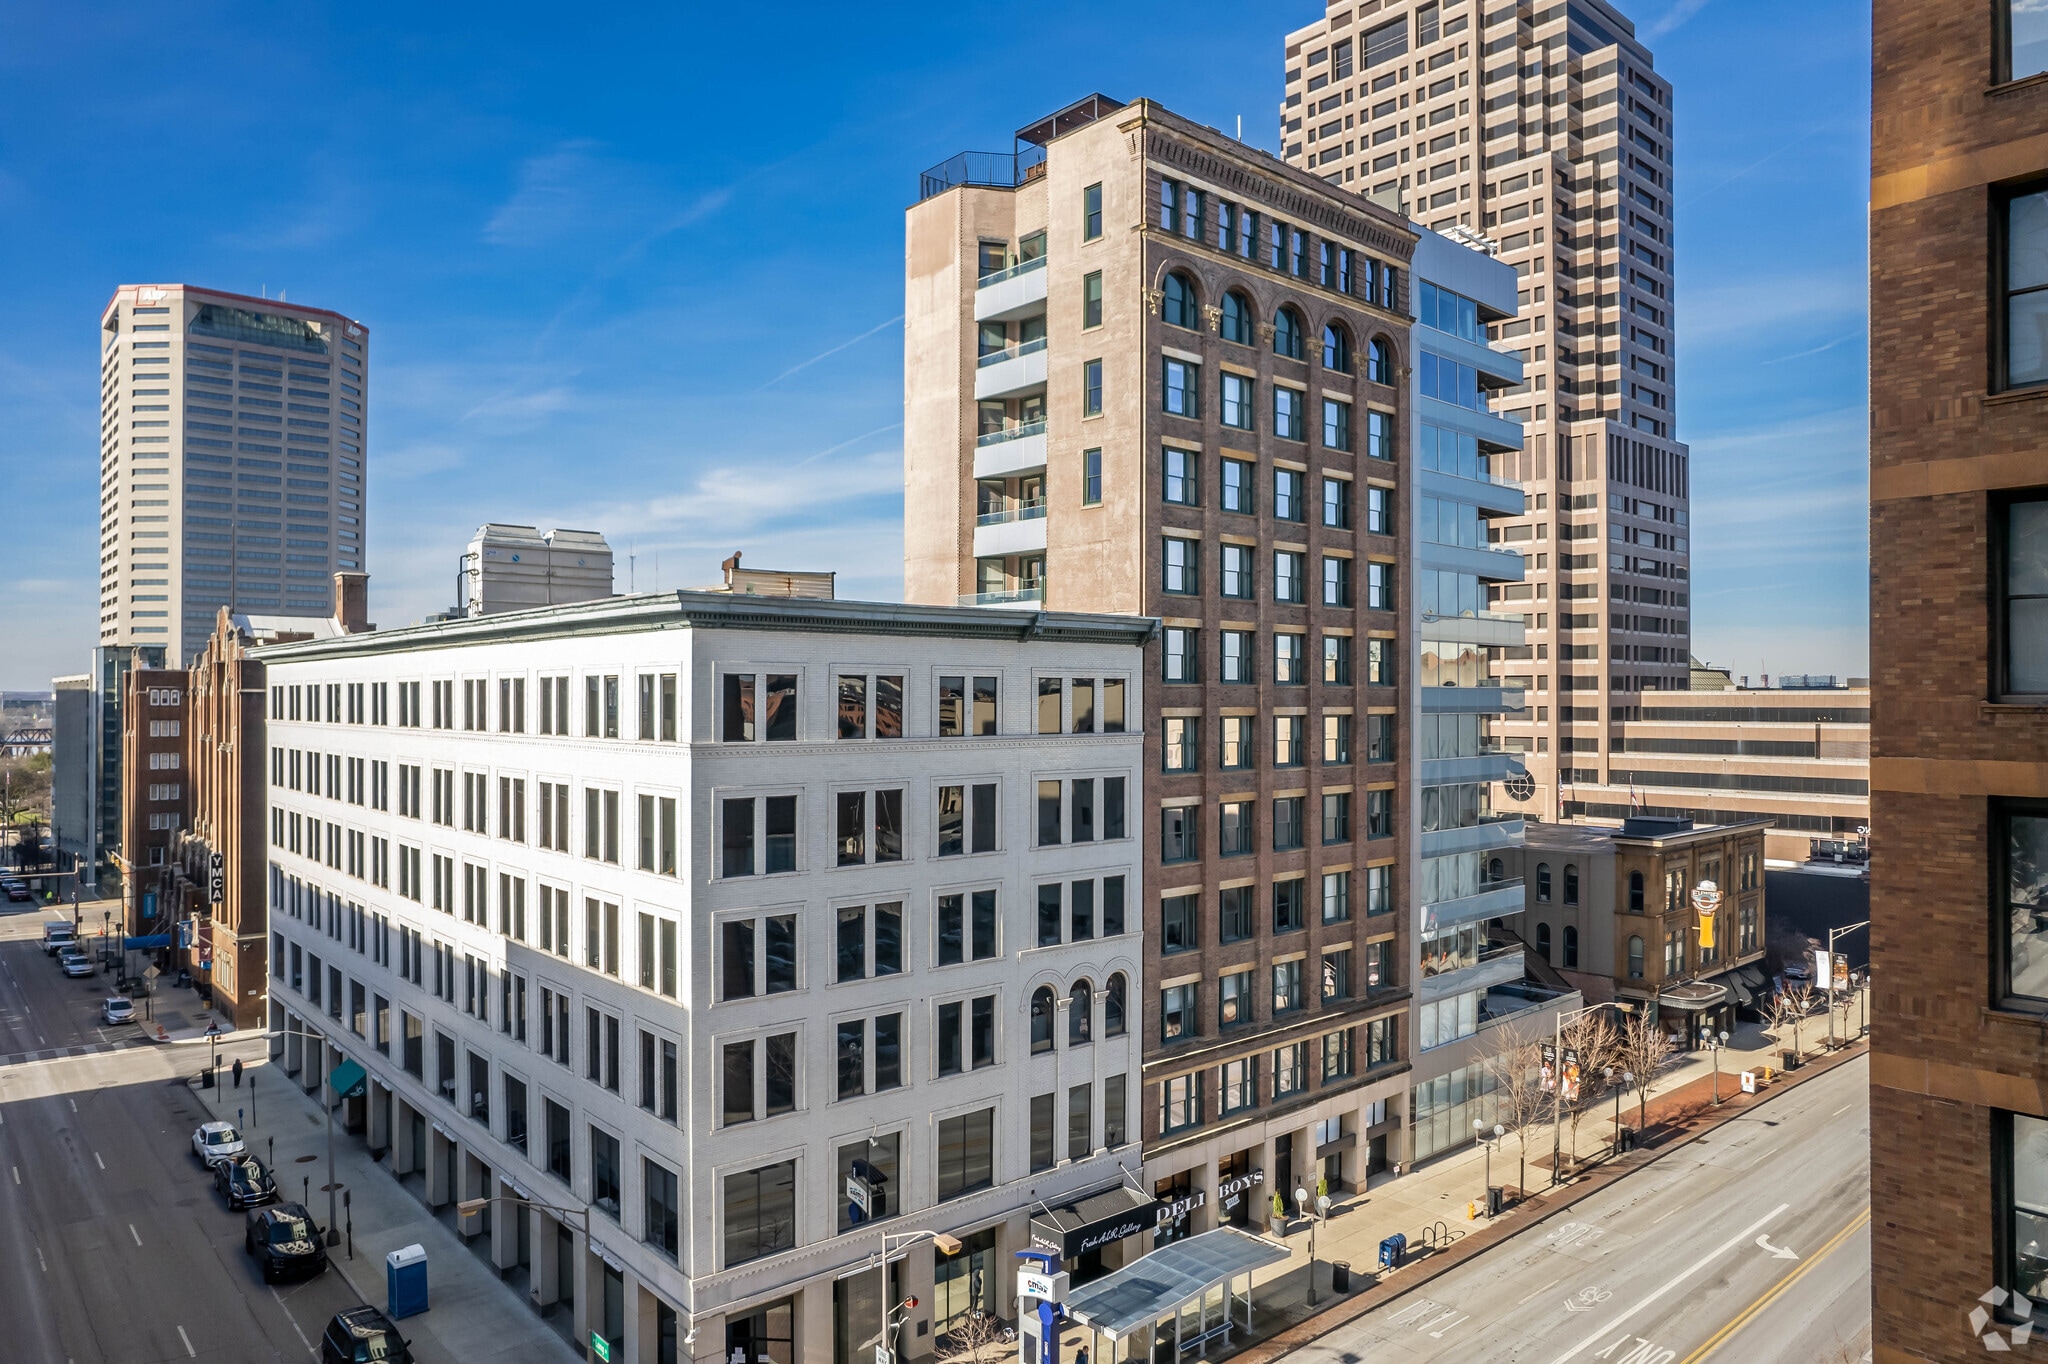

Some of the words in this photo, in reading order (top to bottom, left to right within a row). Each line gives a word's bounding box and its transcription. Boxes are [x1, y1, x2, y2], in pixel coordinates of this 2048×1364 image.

[212, 856, 223, 900] YMCA
[1156, 1192, 1205, 1223] DELI
[1218, 1170, 1264, 1198] BOYS
[1081, 1235, 1098, 1252] Fresh
[1118, 1222, 1141, 1238] Gallery
[1387, 1299, 1471, 1338] TAXI
